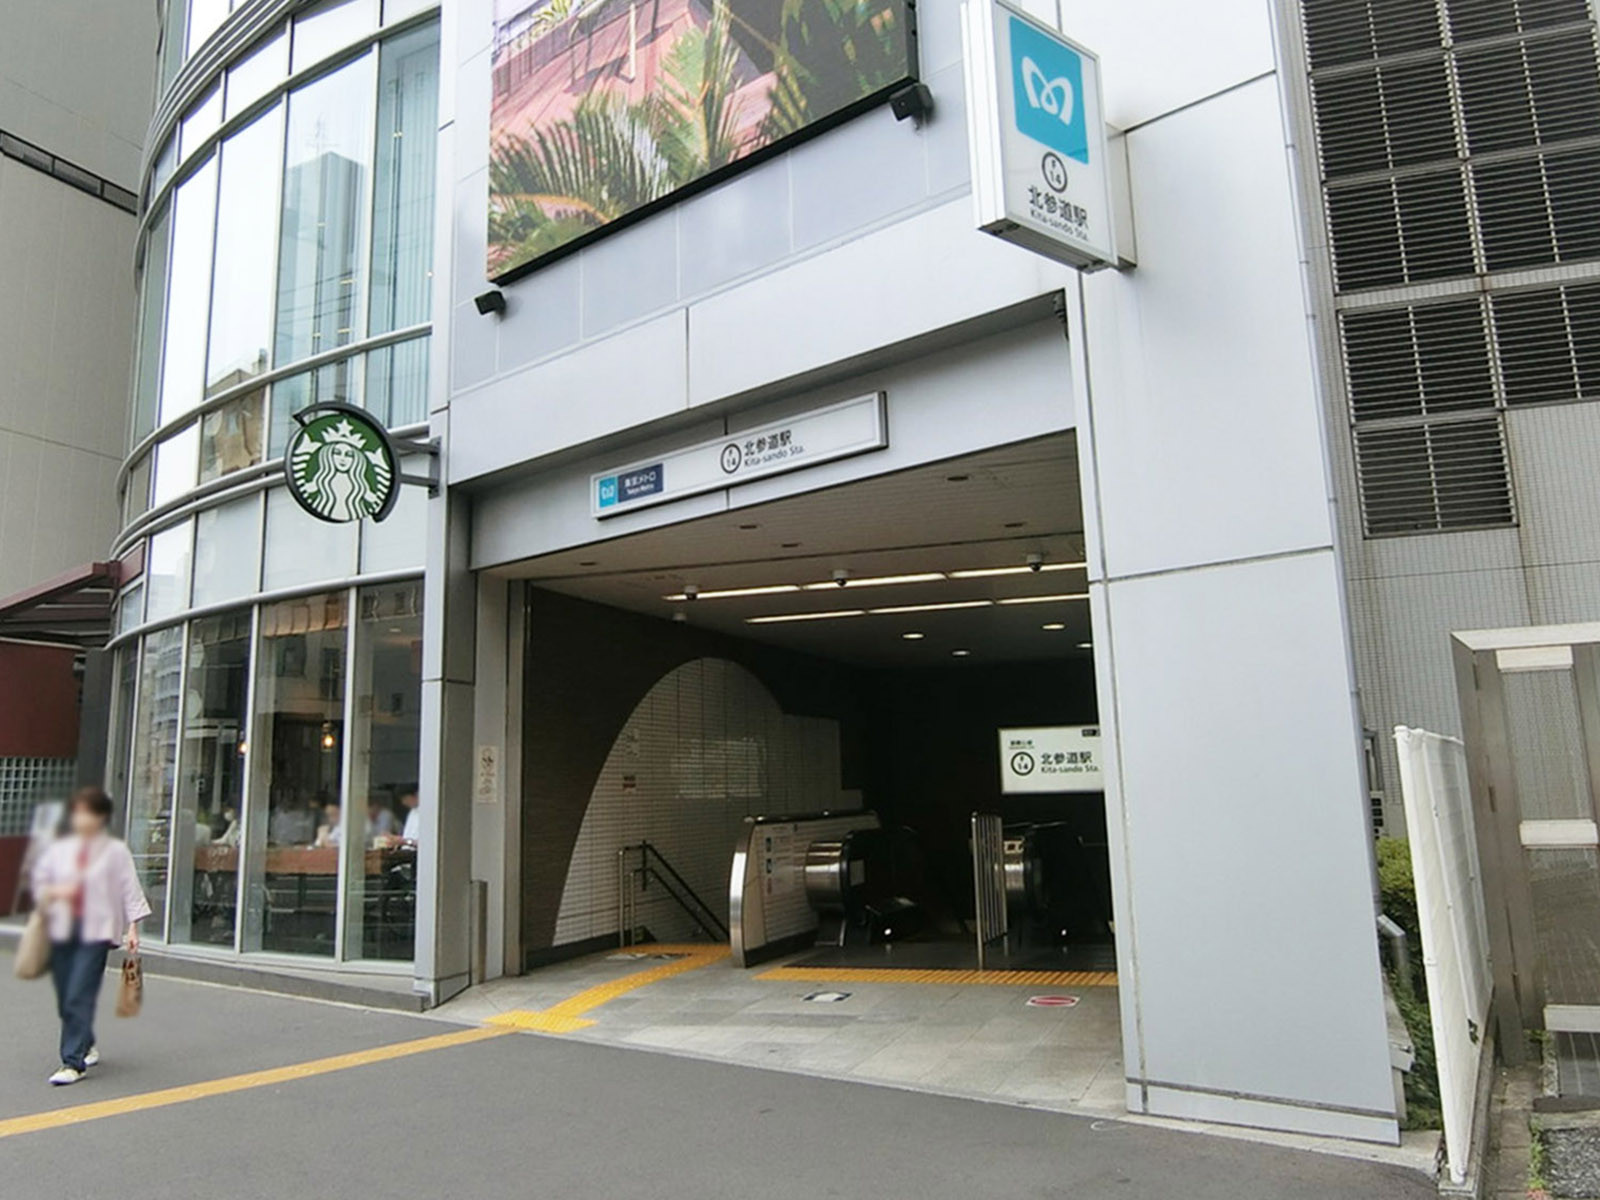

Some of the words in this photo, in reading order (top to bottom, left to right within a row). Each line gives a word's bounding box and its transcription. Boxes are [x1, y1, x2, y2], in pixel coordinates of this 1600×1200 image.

[1028, 185, 1089, 229] 北参道駅
[744, 429, 792, 457] 北参道駅
[726, 457, 737, 468] 14
[1041, 751, 1092, 765] 北参道駅
[1017, 763, 1029, 771] 14
